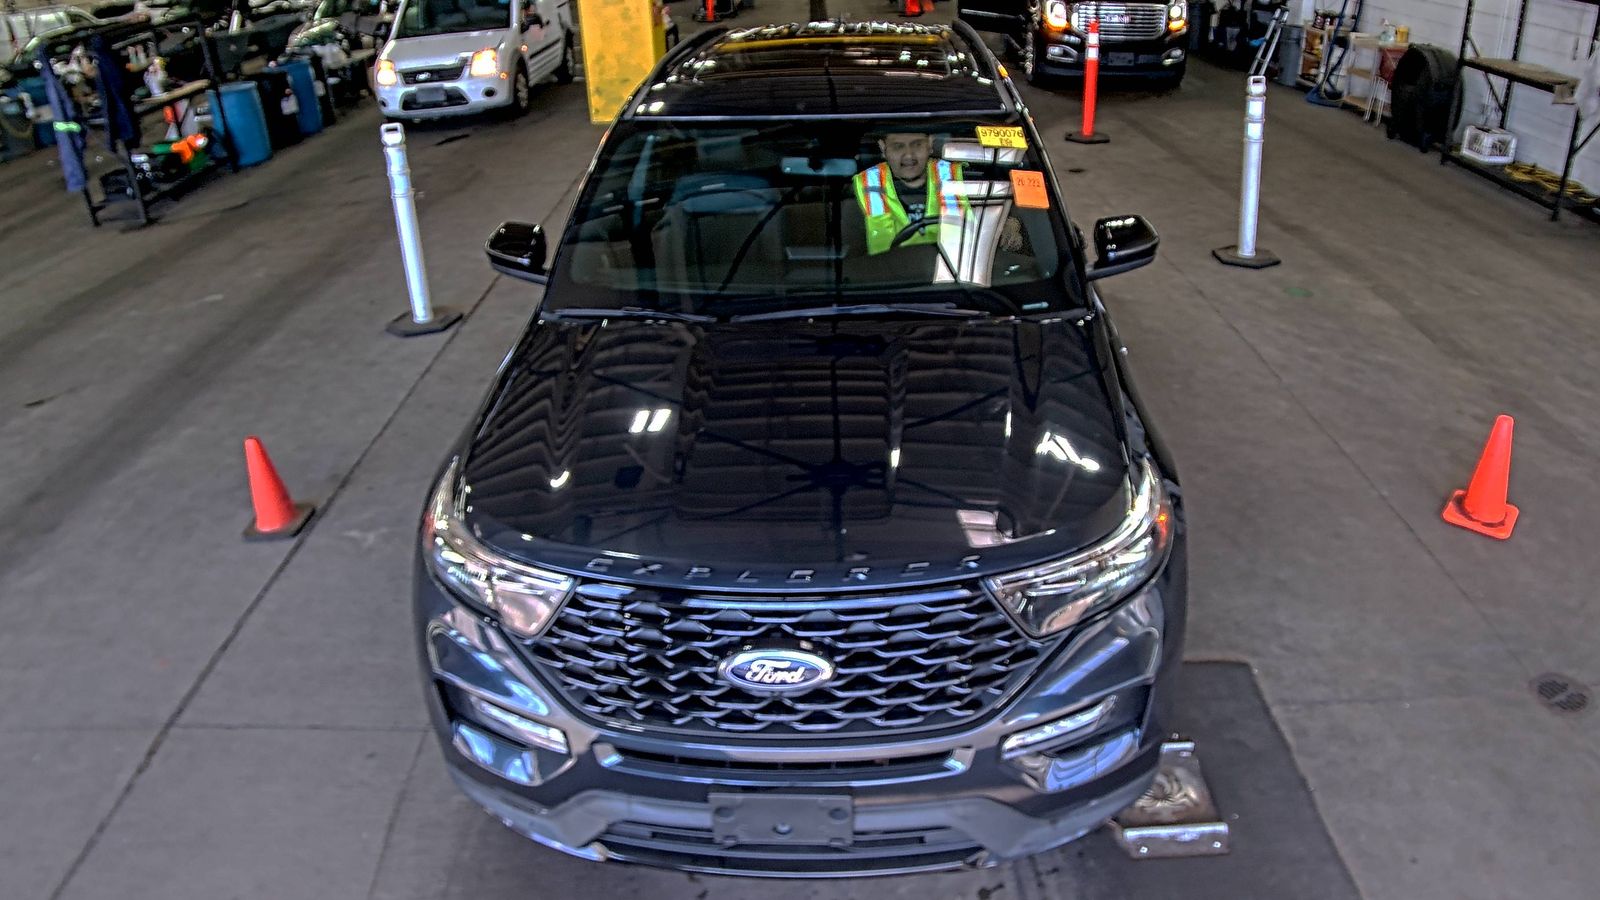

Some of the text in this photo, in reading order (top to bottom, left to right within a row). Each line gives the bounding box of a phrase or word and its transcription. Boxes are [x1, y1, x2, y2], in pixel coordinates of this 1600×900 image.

[980, 128, 1024, 138] 9790076
[585, 555, 981, 583] EXPLORER
[745, 659, 805, 684] Ford
